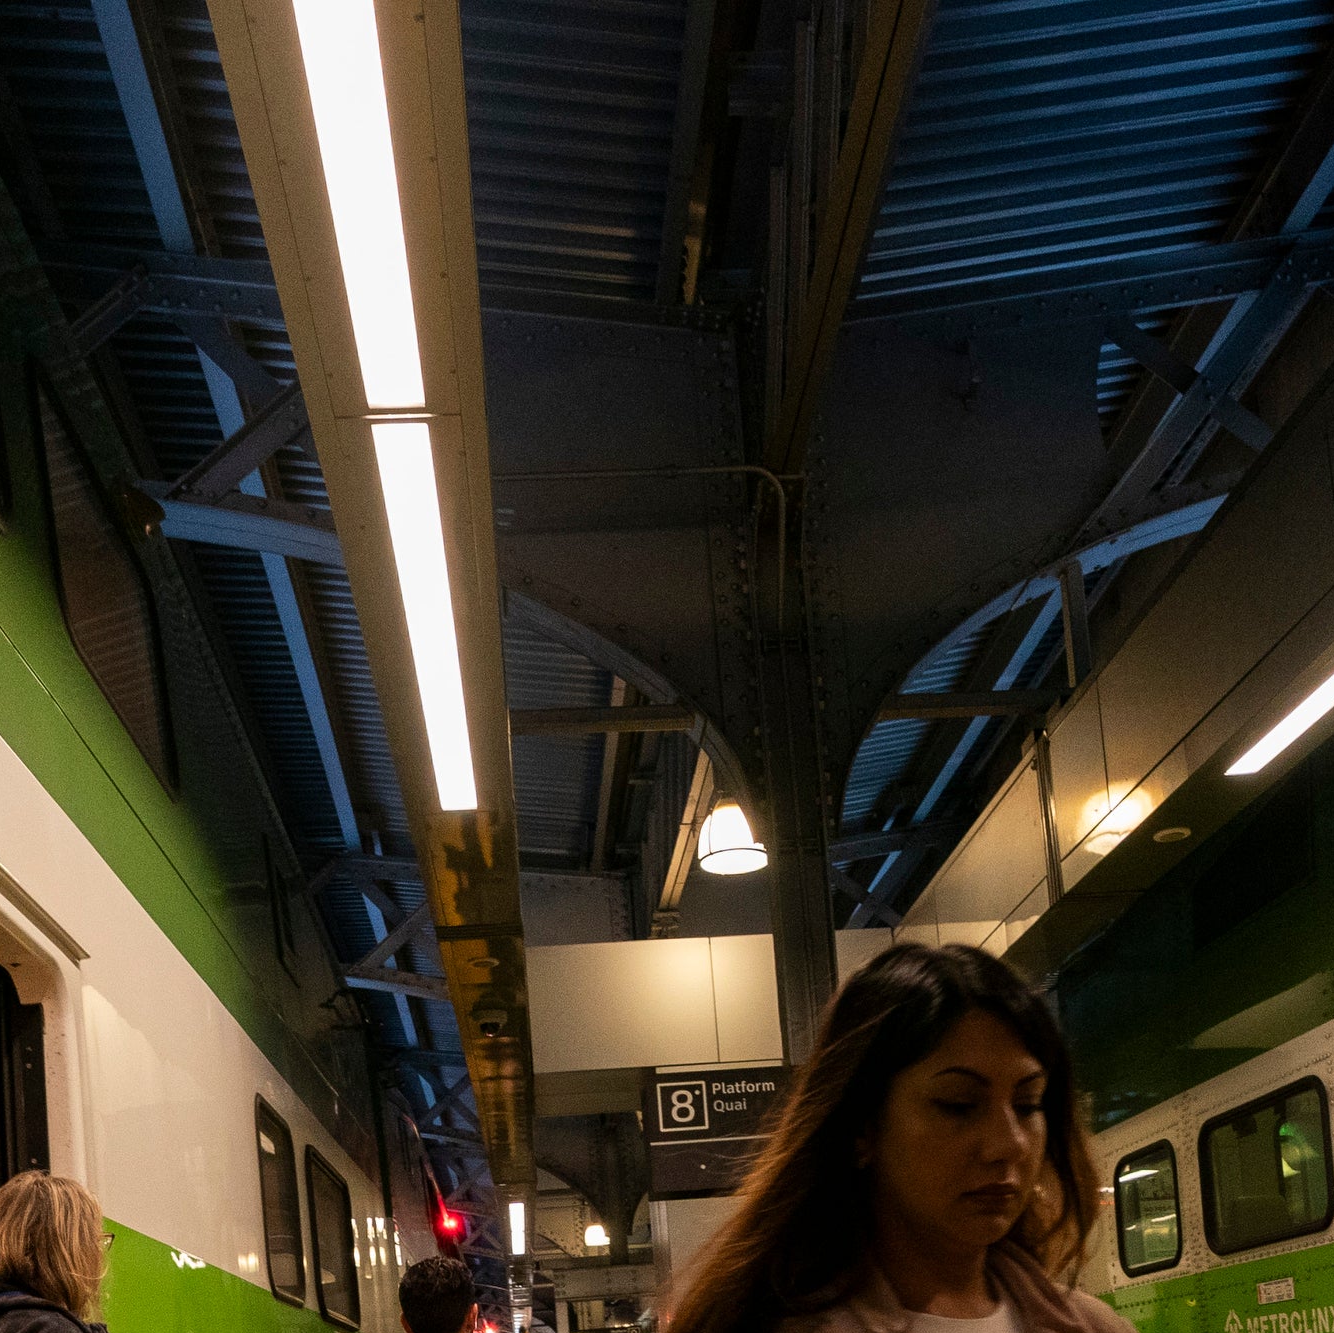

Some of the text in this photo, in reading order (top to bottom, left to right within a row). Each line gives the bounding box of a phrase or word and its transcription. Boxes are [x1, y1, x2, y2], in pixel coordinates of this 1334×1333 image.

[712, 1081, 775, 1095] Platform
[671, 1090, 695, 1122] 8
[713, 1098, 747, 1112] Quai
